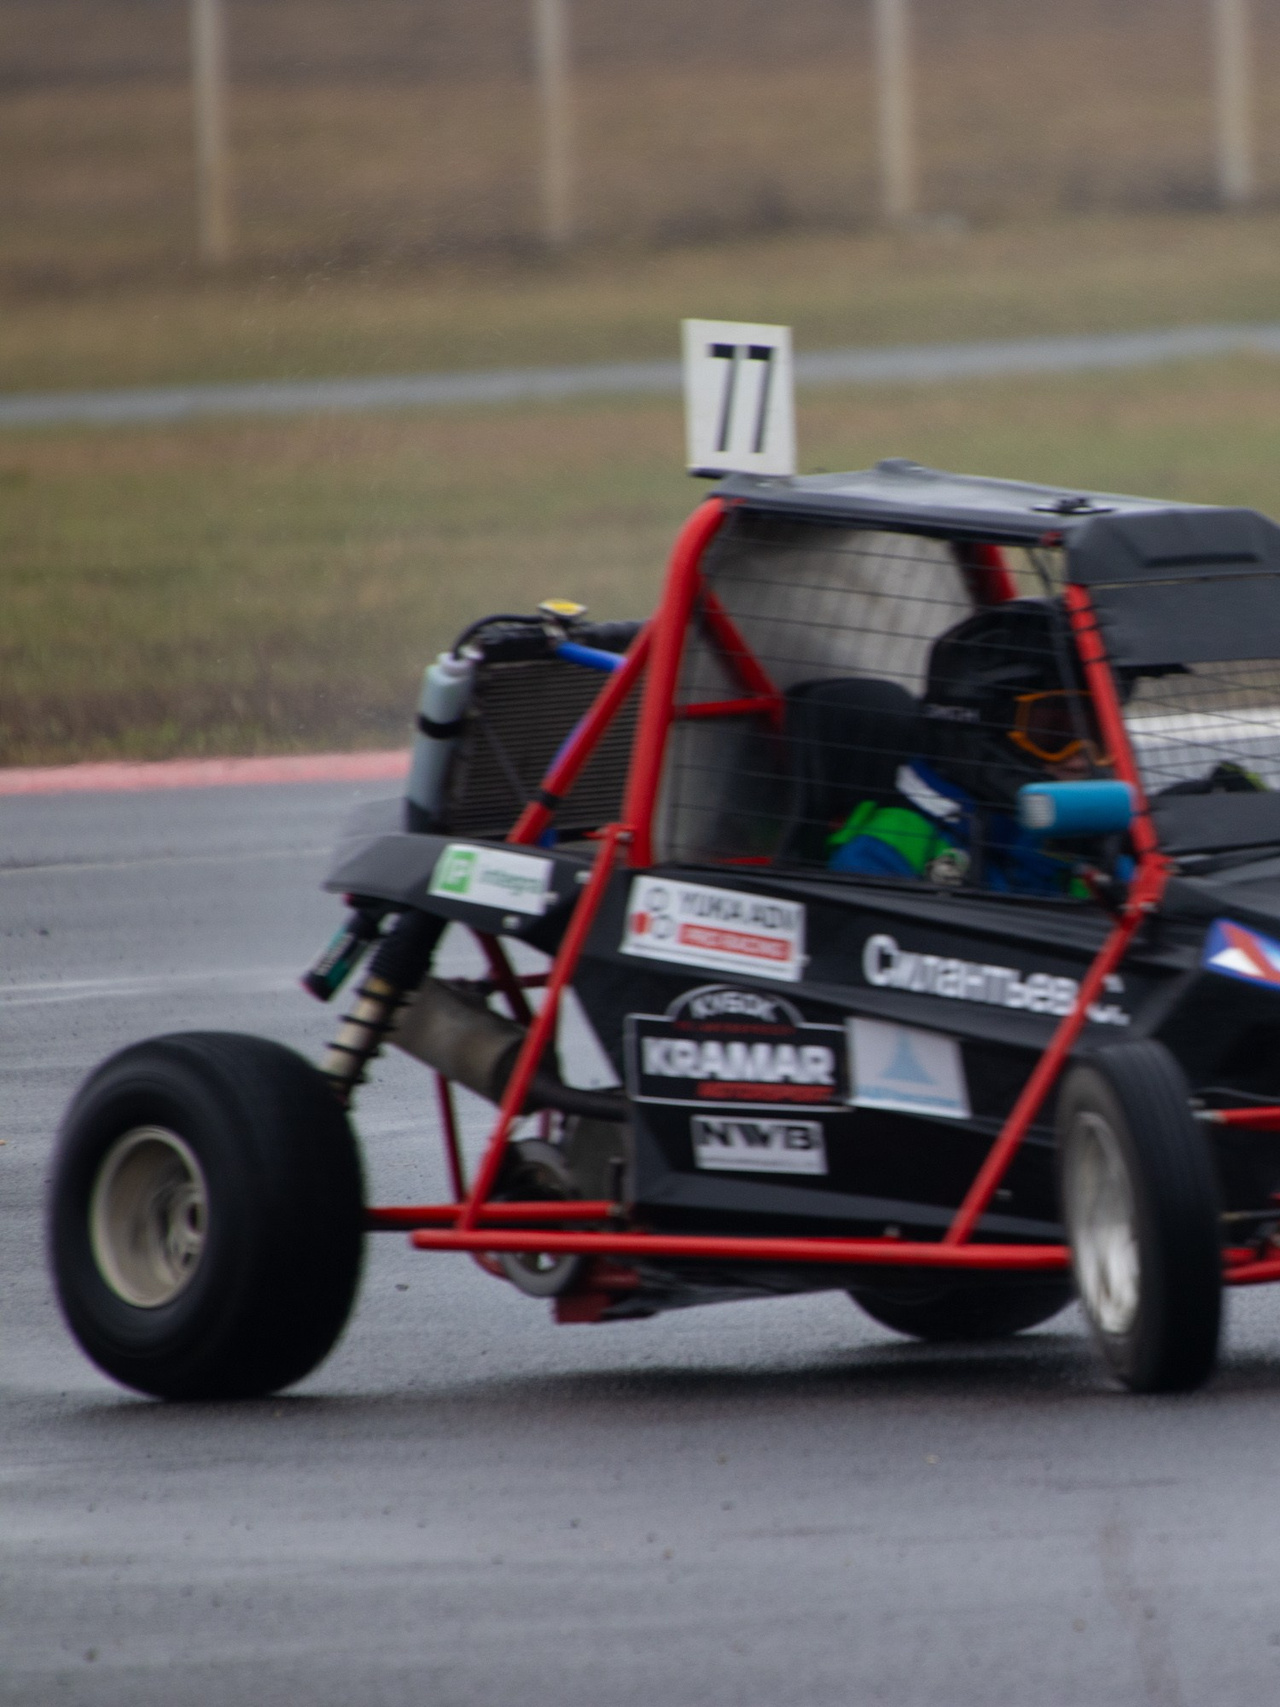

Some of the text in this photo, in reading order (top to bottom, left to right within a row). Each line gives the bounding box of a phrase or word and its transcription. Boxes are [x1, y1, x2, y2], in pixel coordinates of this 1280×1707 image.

[706, 343, 775, 453] 77
[862, 934, 1080, 1017] Силантьев
[641, 1036, 836, 1086] KRAMAR
[691, 1120, 820, 1150] NWB
